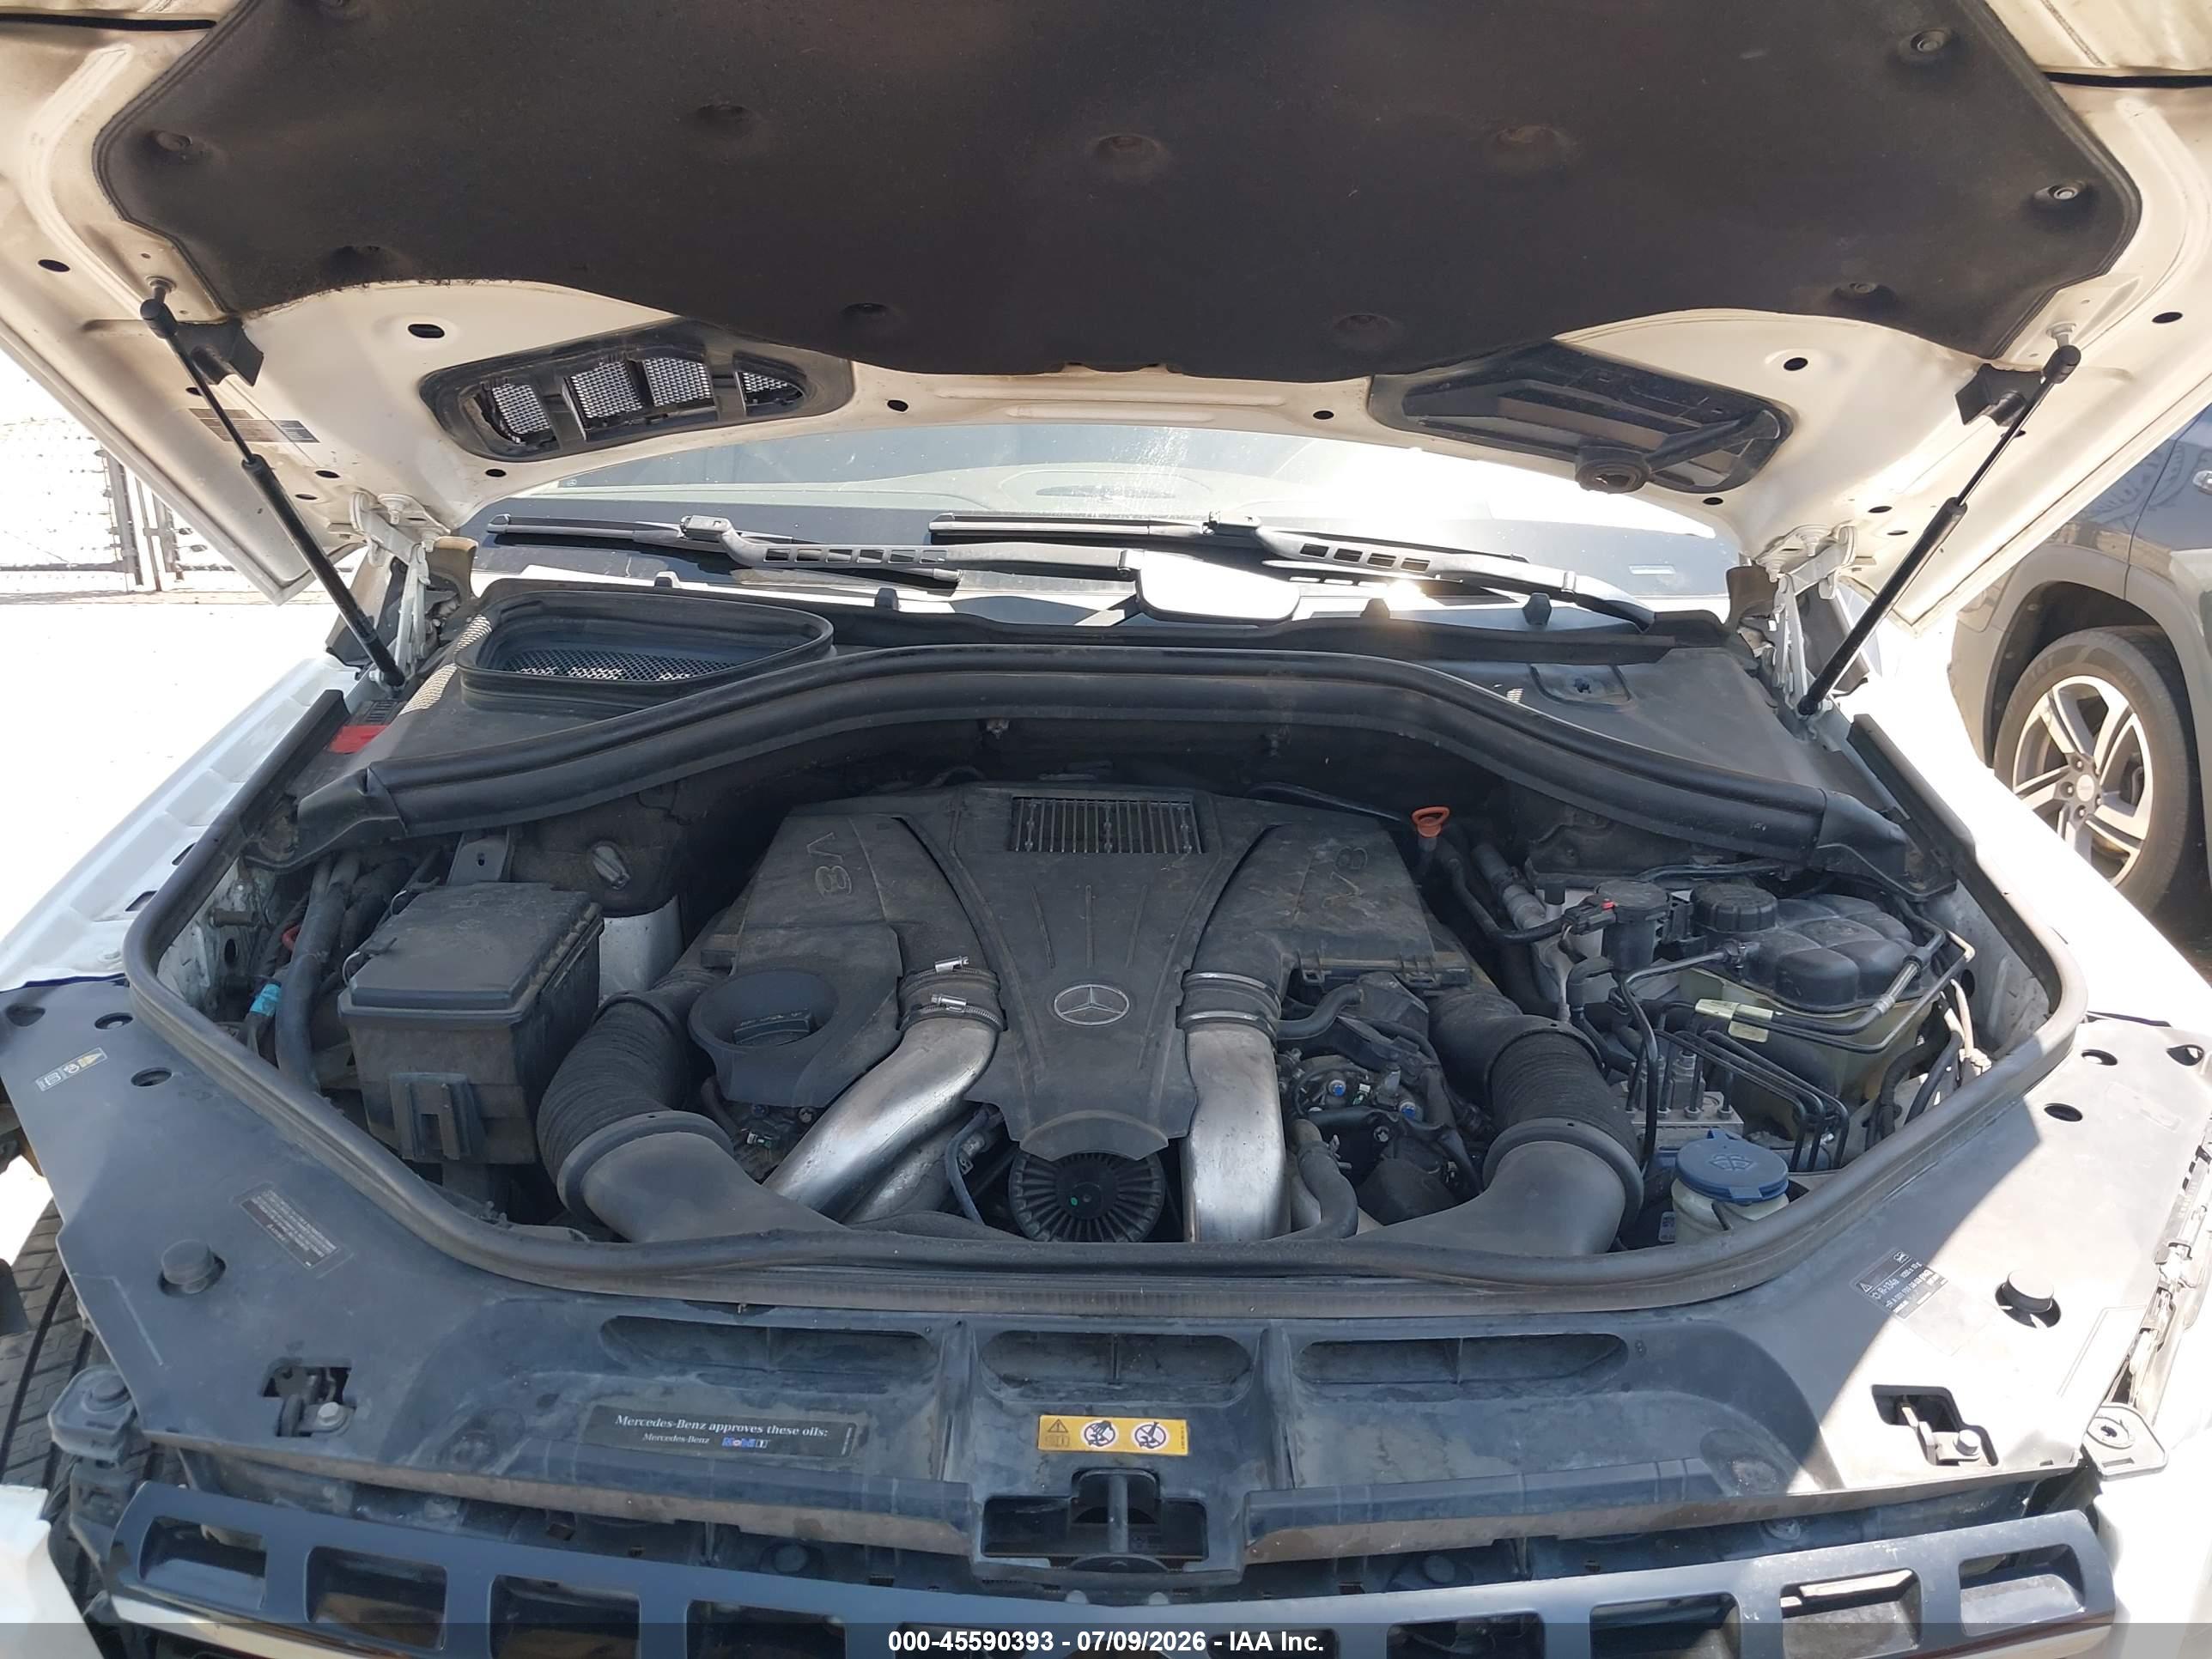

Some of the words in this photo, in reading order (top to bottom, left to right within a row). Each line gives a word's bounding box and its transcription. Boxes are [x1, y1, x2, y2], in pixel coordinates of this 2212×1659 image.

[806, 831, 852, 898] V8
[615, 1414, 707, 1430] Mercedes-Benz
[708, 1422, 763, 1433] approves
[766, 1425, 799, 1436] these
[802, 1426, 829, 1437] oils:
[641, 1432, 710, 1443] Mercedes-Benz
